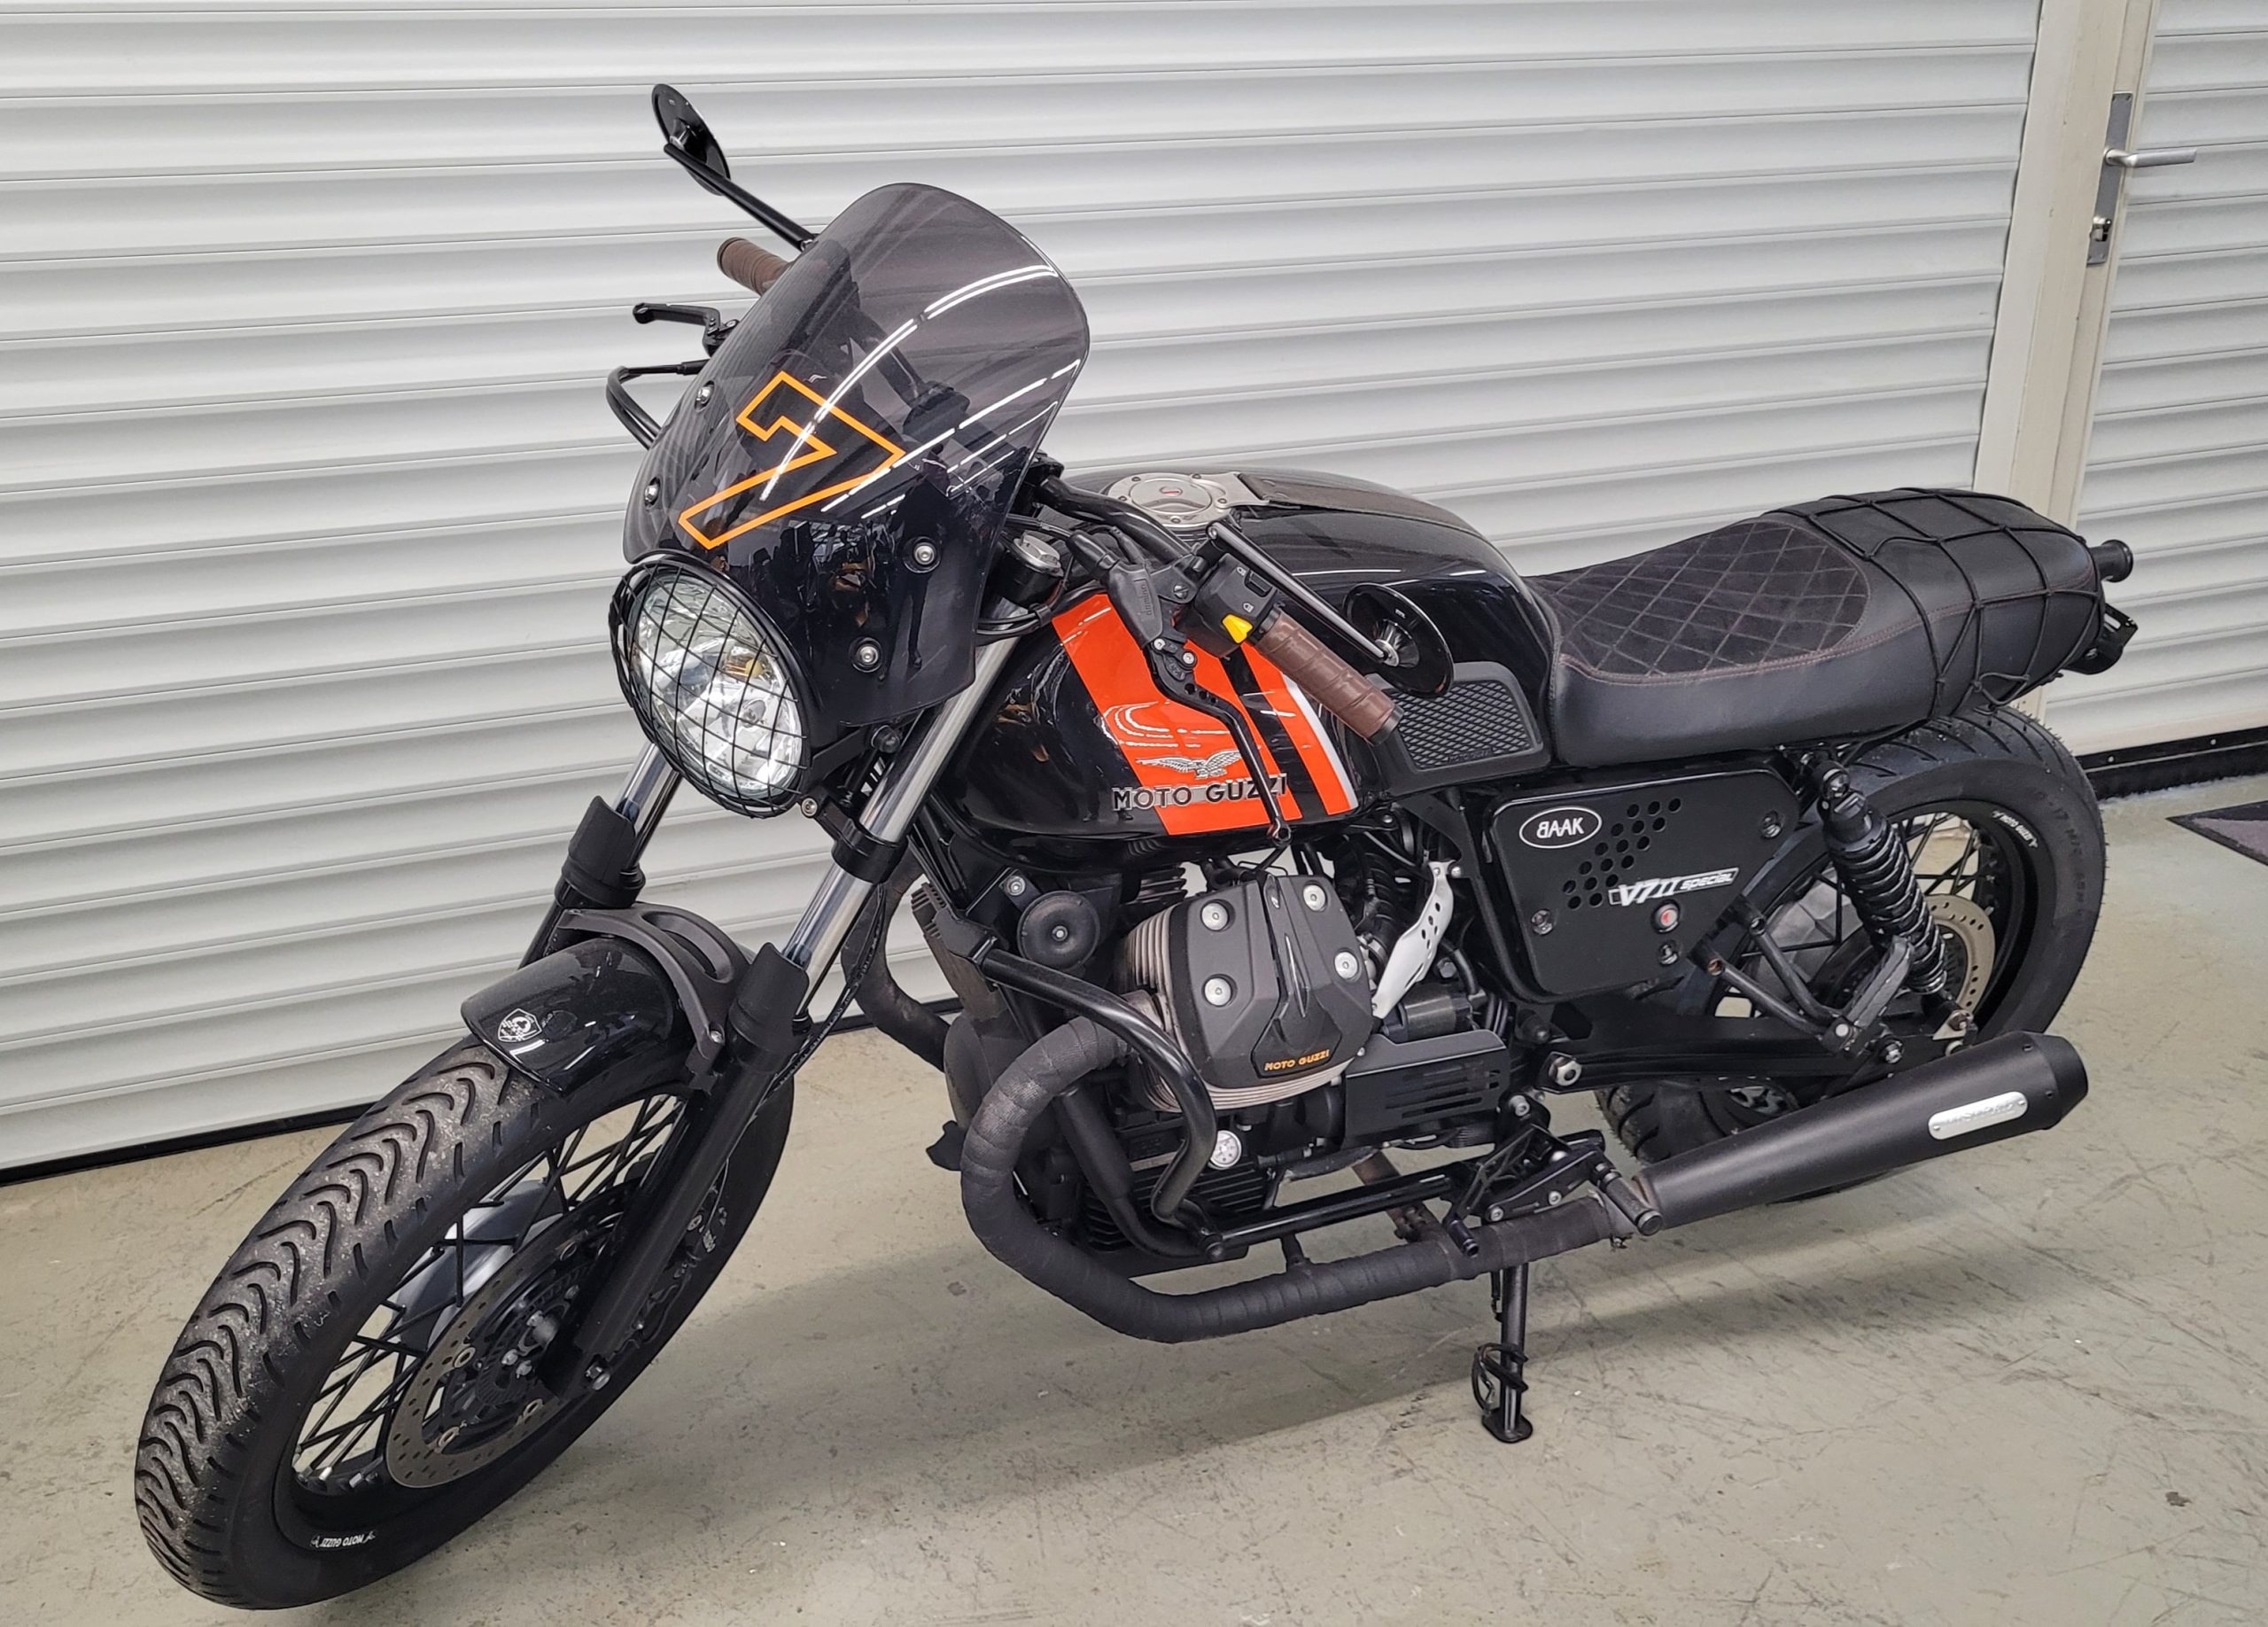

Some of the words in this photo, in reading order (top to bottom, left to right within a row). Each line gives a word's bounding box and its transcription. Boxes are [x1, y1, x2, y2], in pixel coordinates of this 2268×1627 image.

[679, 370, 906, 550] 7
[1112, 786, 1192, 812] MOTO
[1536, 817, 1585, 839] BAAK
[1264, 1059, 1296, 1071] MOTO
[1298, 1048, 1330, 1065] GUZZI
[319, 1537, 342, 1548] GUZZI
[342, 1534, 365, 1547] MOTO
